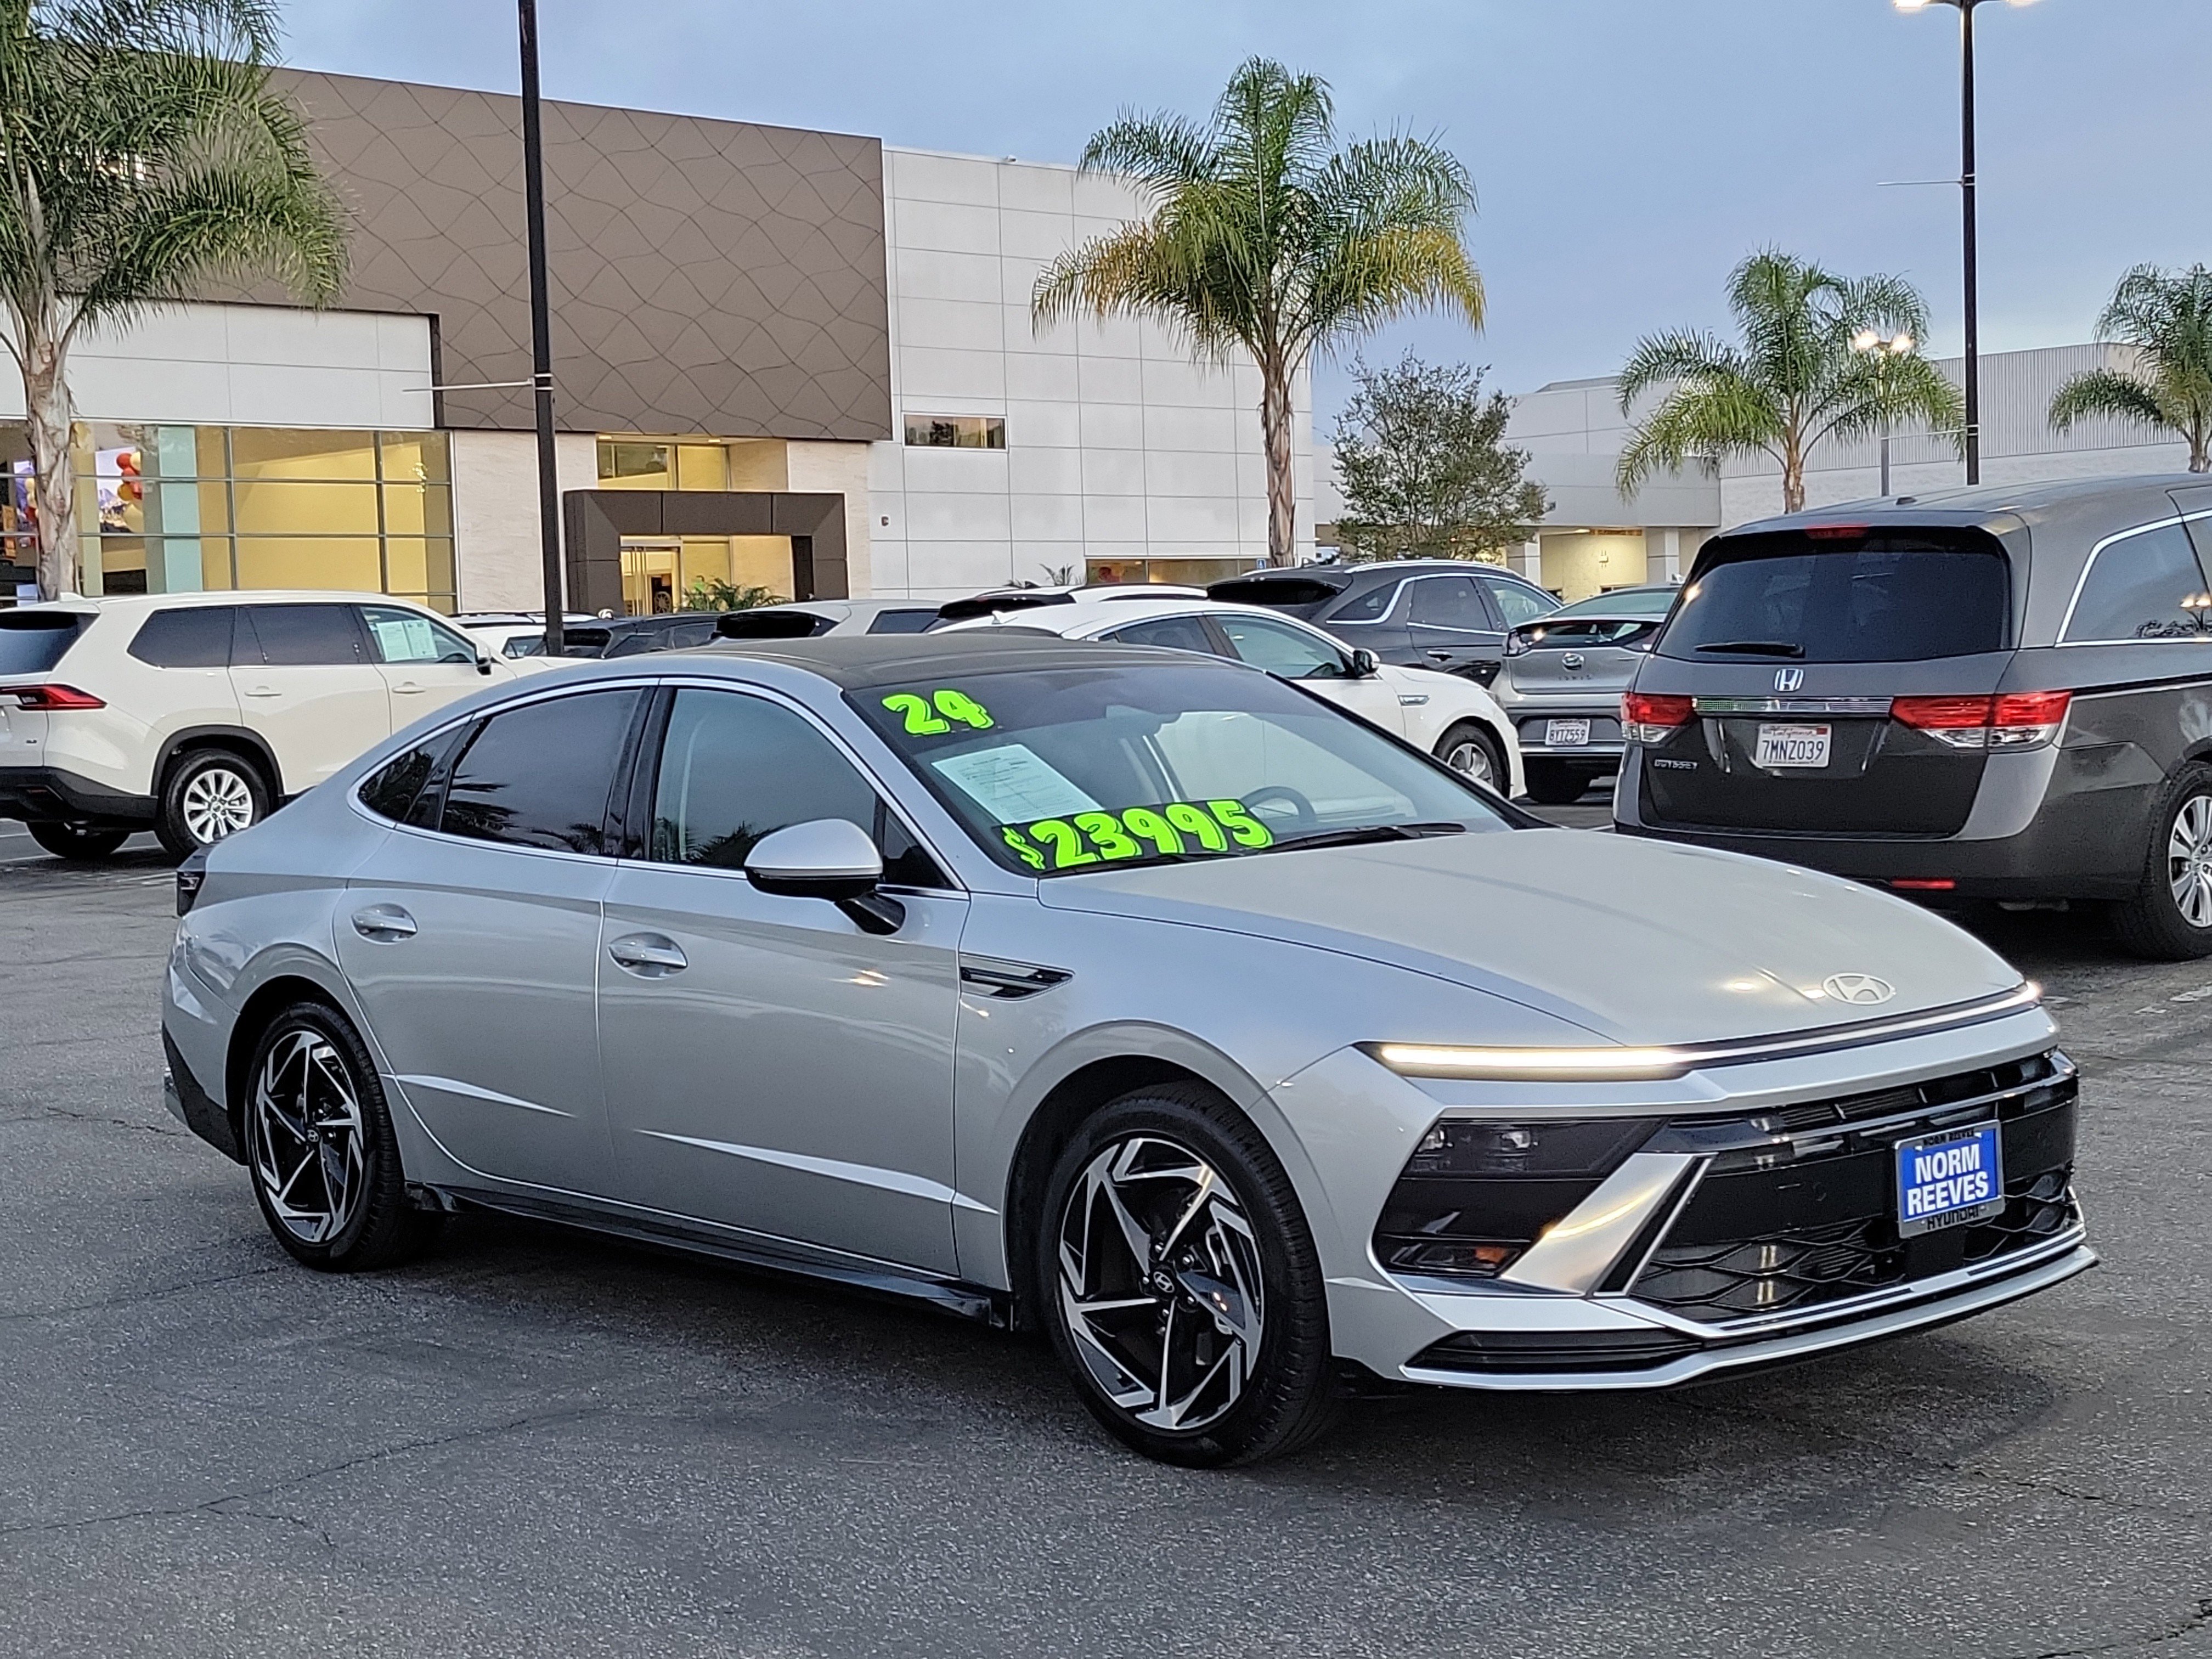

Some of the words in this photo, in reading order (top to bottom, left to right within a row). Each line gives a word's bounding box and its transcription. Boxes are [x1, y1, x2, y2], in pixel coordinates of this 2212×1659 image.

[881, 690, 995, 735] 24
[1762, 740, 1825, 760] 7MNZ039
[1001, 800, 1274, 870] $23995
[1915, 1143, 1980, 1184] NORM
[1907, 1171, 1989, 1216] REEVES
